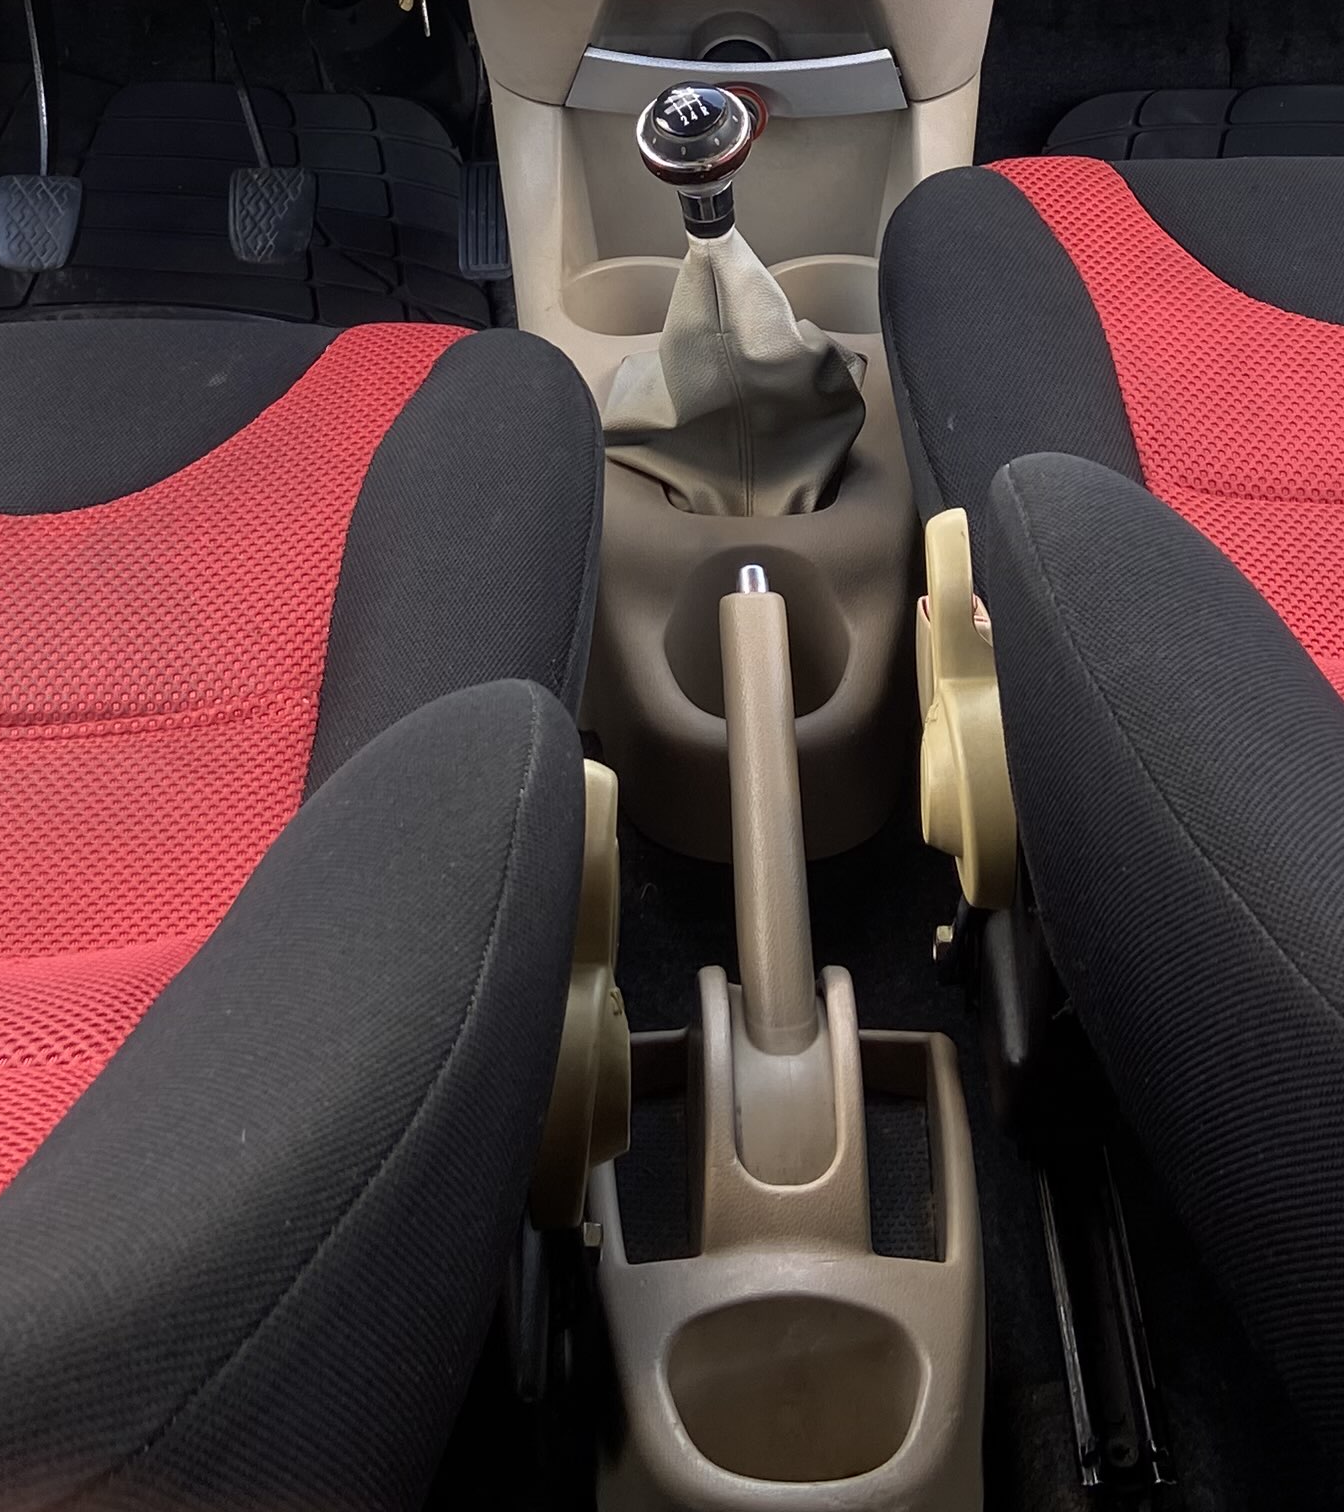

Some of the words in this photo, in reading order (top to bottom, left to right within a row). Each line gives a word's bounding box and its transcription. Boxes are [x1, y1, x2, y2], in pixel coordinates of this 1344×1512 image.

[680, 115, 690, 127] 2
[690, 110, 698, 120] 4
[700, 105, 710, 116] R
